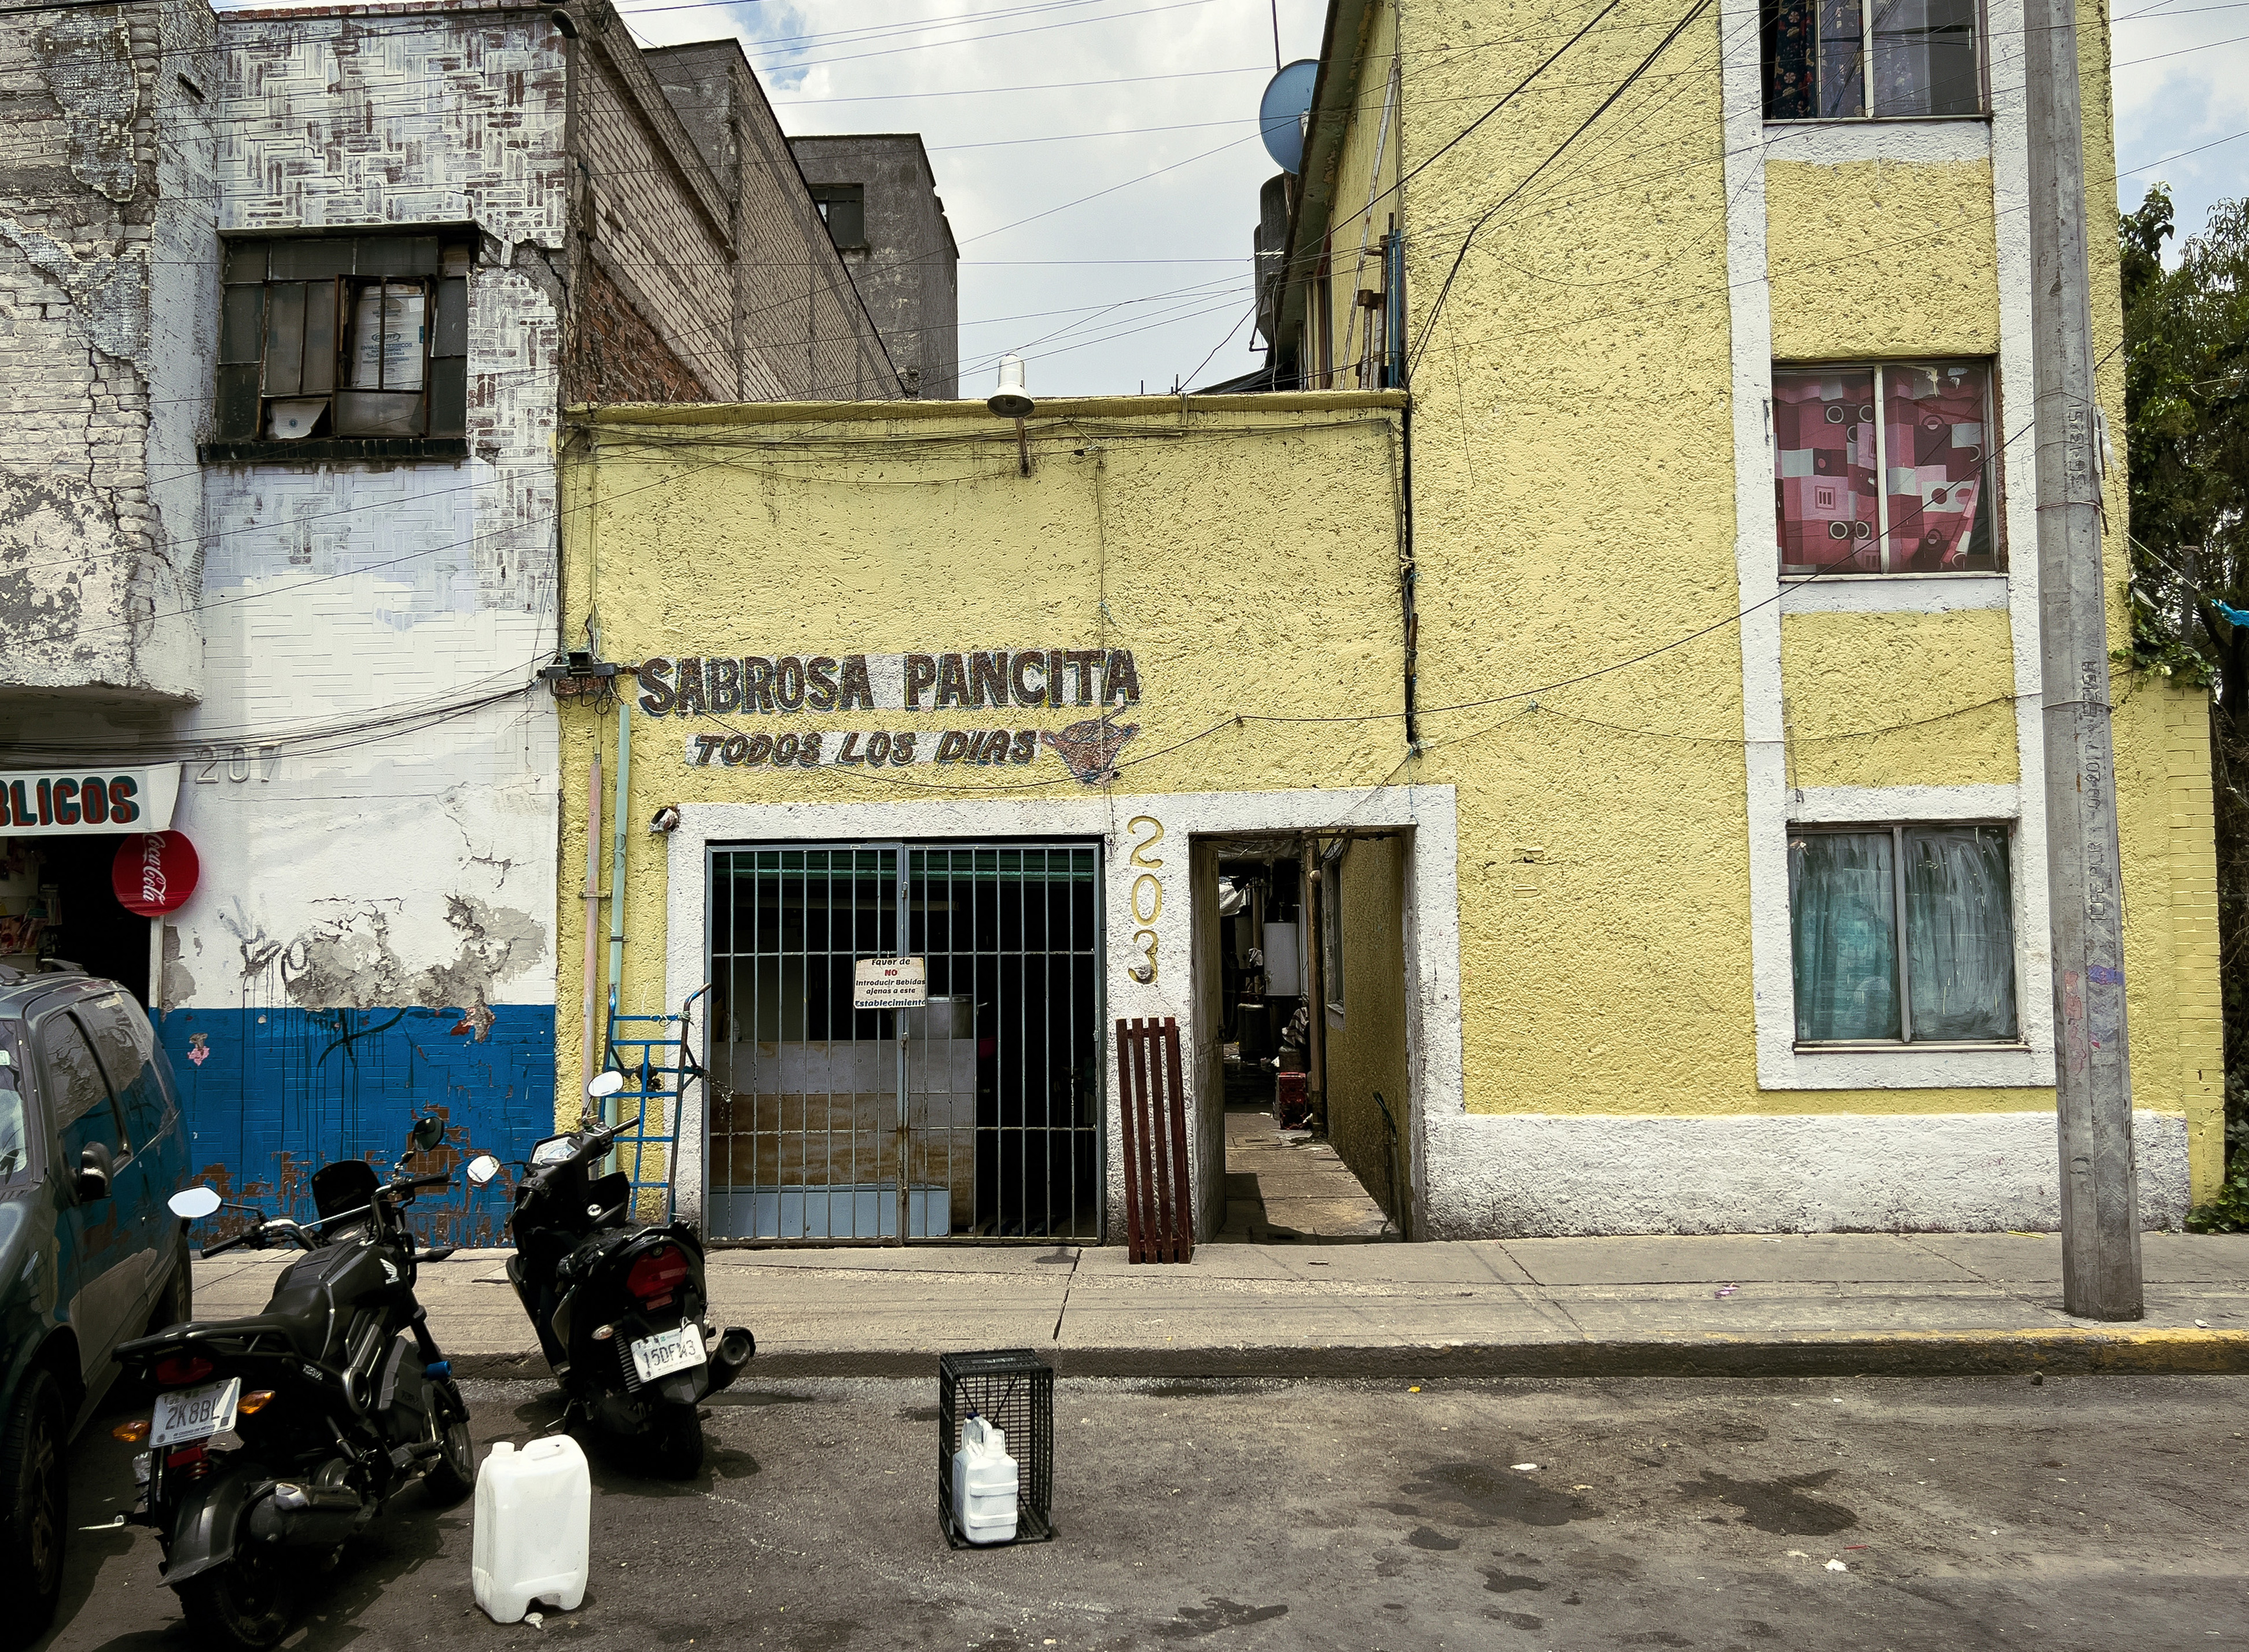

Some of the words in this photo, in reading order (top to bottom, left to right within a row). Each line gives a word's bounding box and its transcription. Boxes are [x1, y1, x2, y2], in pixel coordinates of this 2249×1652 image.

[638, 655, 875, 716] SABROSA
[904, 649, 1140, 711] PANCITA
[196, 744, 282, 784] 207
[694, 731, 823, 768] TODOS
[835, 731, 916, 768] LOS
[934, 729, 1037, 766] DIAS
[1127, 815, 1164, 984] 203
[866, 987, 892, 995] ajenas
[165, 1397, 220, 1430] 2K8BL
